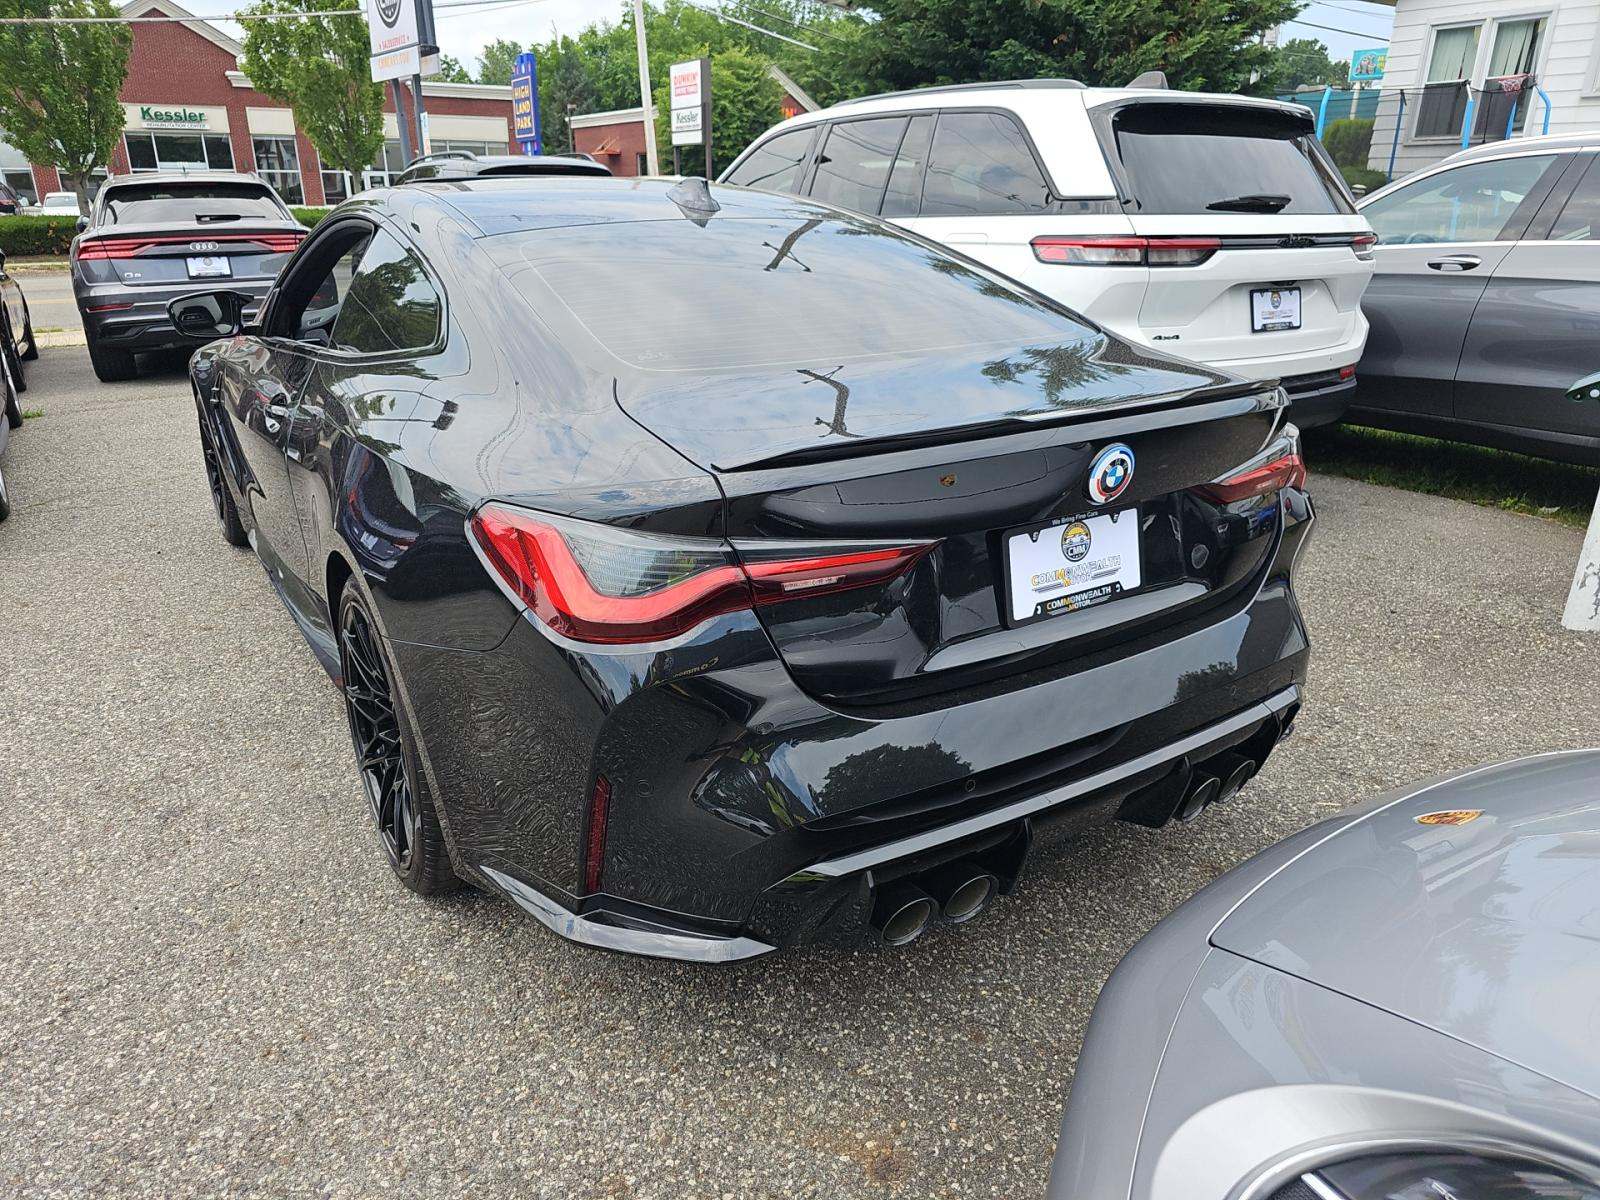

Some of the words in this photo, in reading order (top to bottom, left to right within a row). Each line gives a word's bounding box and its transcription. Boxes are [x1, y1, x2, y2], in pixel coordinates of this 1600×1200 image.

[513, 85, 529, 98] HIGH
[140, 106, 206, 121] Kessler
[515, 100, 531, 115] LAND
[516, 115, 532, 129] PARK
[676, 110, 699, 123] Kessler
[1031, 554, 1121, 587] COMMONWEALTH
[1046, 585, 1112, 610] COMMONWEALTH
